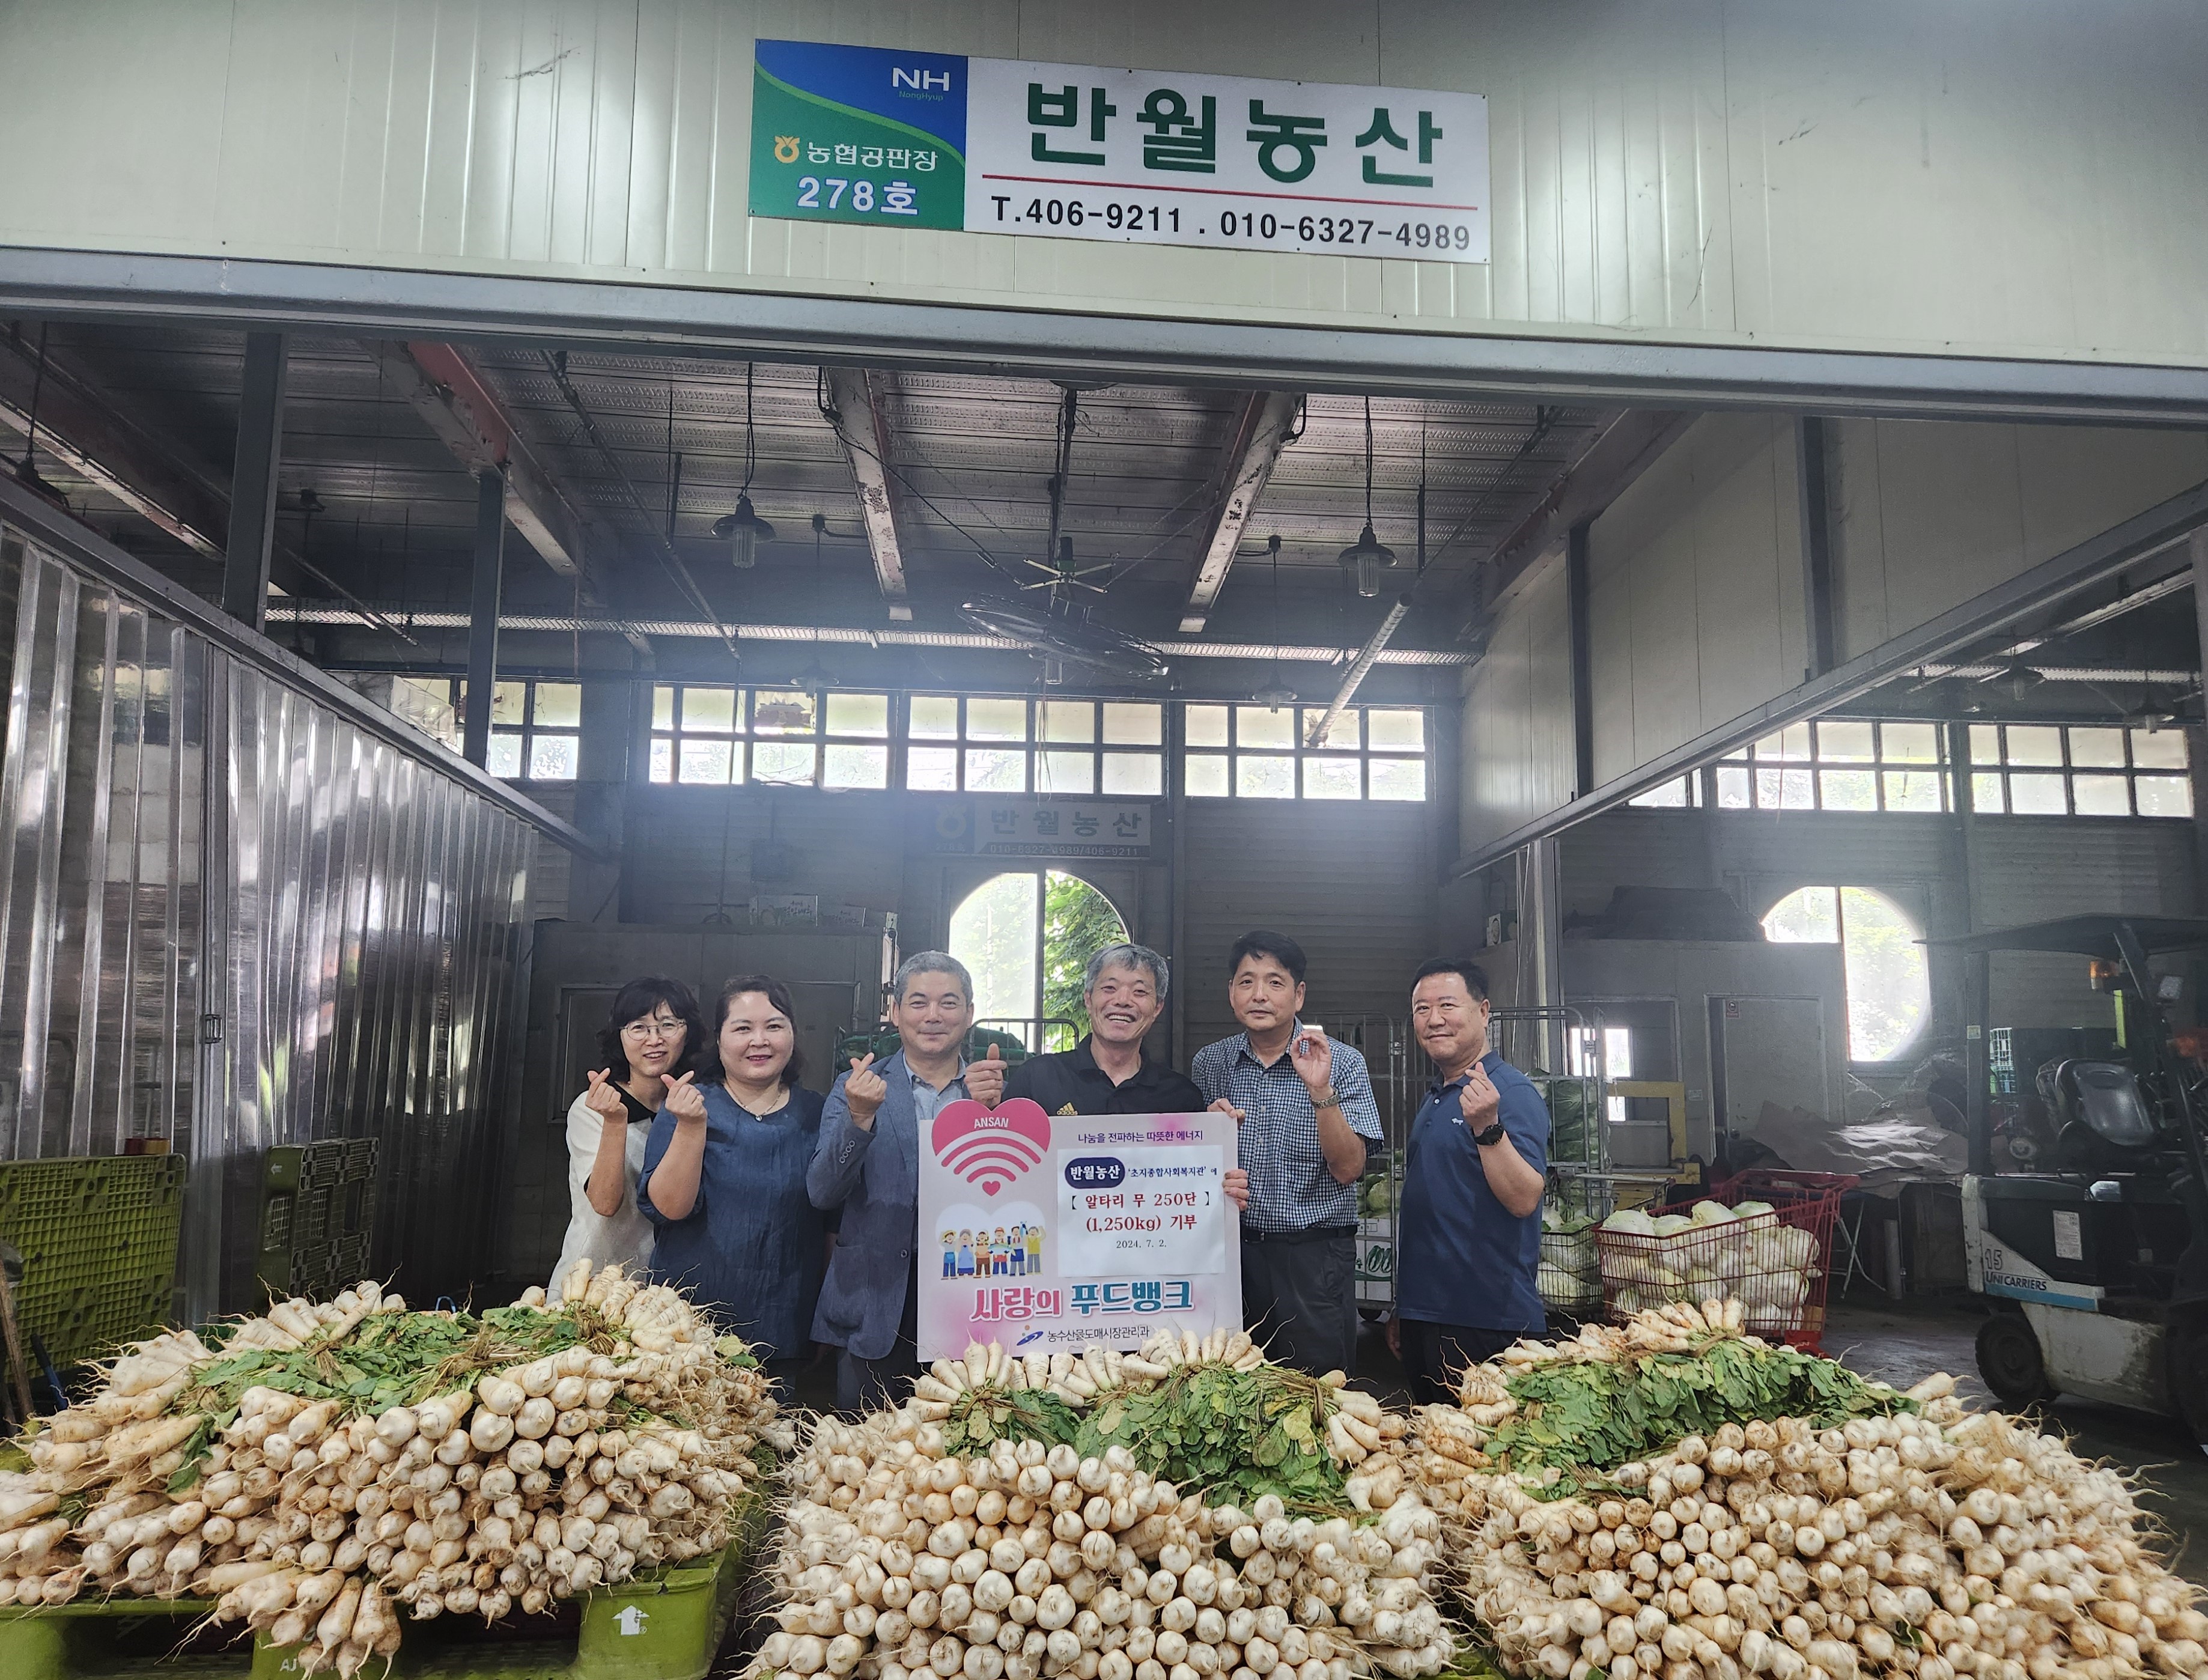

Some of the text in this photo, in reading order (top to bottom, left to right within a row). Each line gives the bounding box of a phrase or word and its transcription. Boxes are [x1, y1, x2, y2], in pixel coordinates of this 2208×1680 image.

[892, 67, 950, 91] NH
[899, 91, 944, 102] NongHyup
[1027, 82, 1443, 187] 반월농산
[807, 142, 938, 172] 농협공판장
[797, 177, 918, 215] 278호
[991, 195, 1179, 233] T.406-9211
[1220, 210, 1470, 251] 010-6327-4989
[991, 809, 1142, 838] 반월농산
[974, 1116, 1009, 1129] ANSAN
[1078, 1130, 1203, 1143] 나눔을 전파하는 따뜻한 에너지
[1069, 1164, 1121, 1181] 반월농산
[1085, 1193, 1124, 1209] 알타리
[1133, 1193, 1146, 1208] 무
[1154, 1192, 1197, 1207] 250단
[1086, 1214, 1197, 1233] (1,250kg) 기부
[970, 1281, 1193, 1320] 사랑의 푸드뱅크
[1047, 1325, 1150, 1342] 농수산물도매시장관리과
